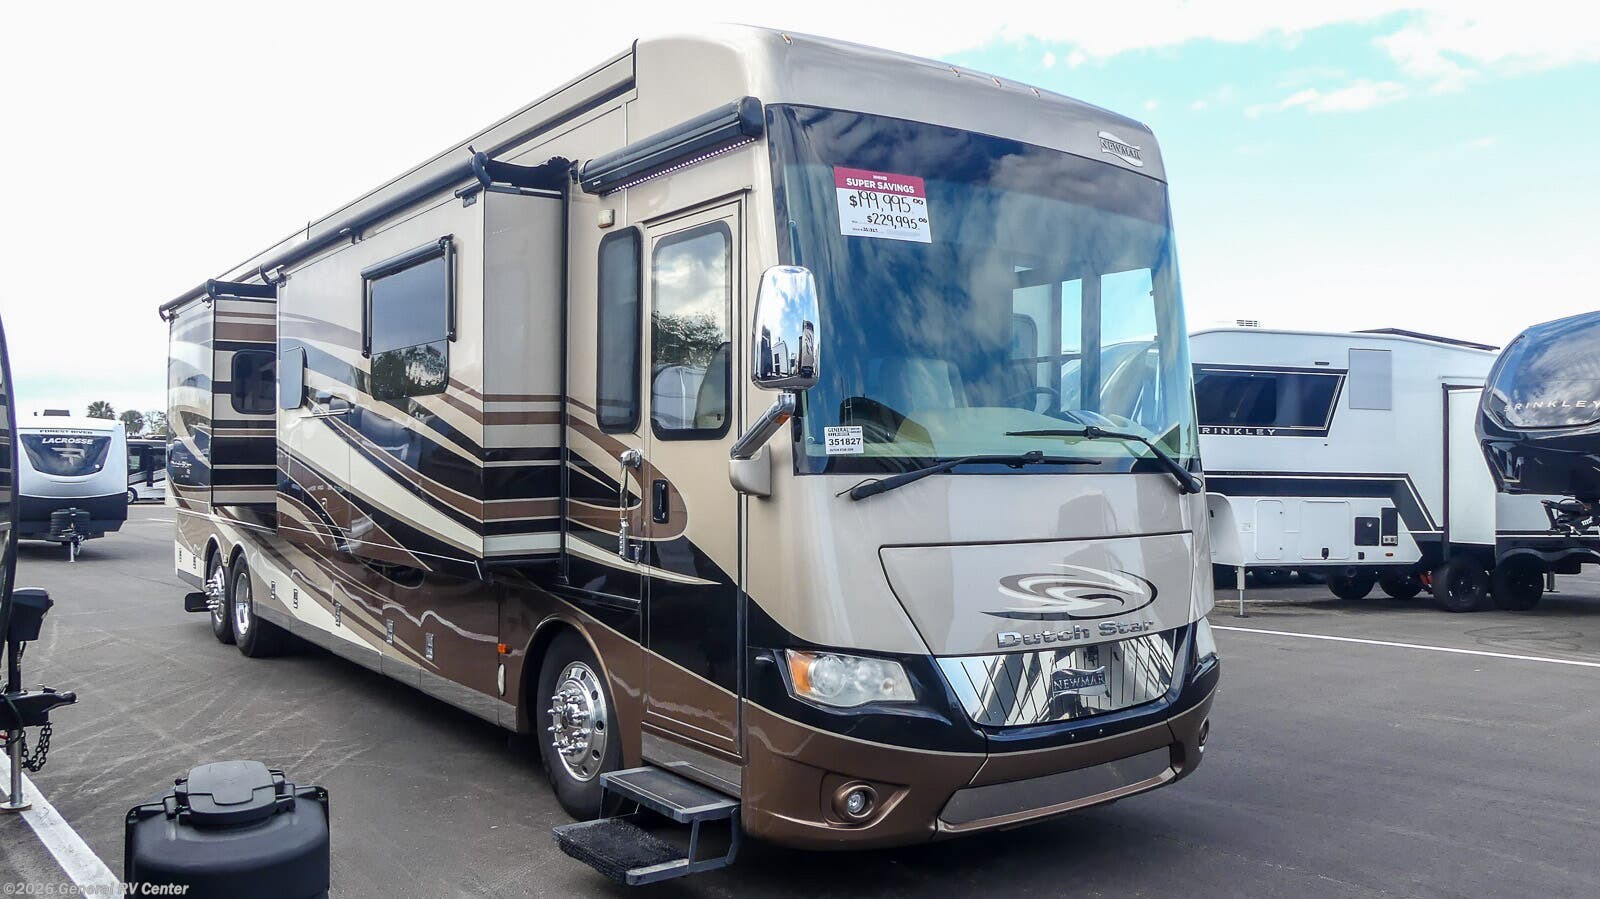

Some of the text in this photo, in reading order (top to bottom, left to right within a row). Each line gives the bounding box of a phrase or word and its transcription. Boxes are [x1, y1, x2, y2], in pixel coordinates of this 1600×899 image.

[1100, 139, 1141, 161] NEWMAR
[846, 177, 876, 189] SUPER
[877, 181, 915, 194] SAVINGS
[1202, 427, 1276, 436] RINKLEY
[42, 437, 94, 445] LACROSSE
[828, 437, 861, 446] 351827
[997, 619, 1154, 649] Dutch Star
[1052, 671, 1106, 692] NEWMAR
